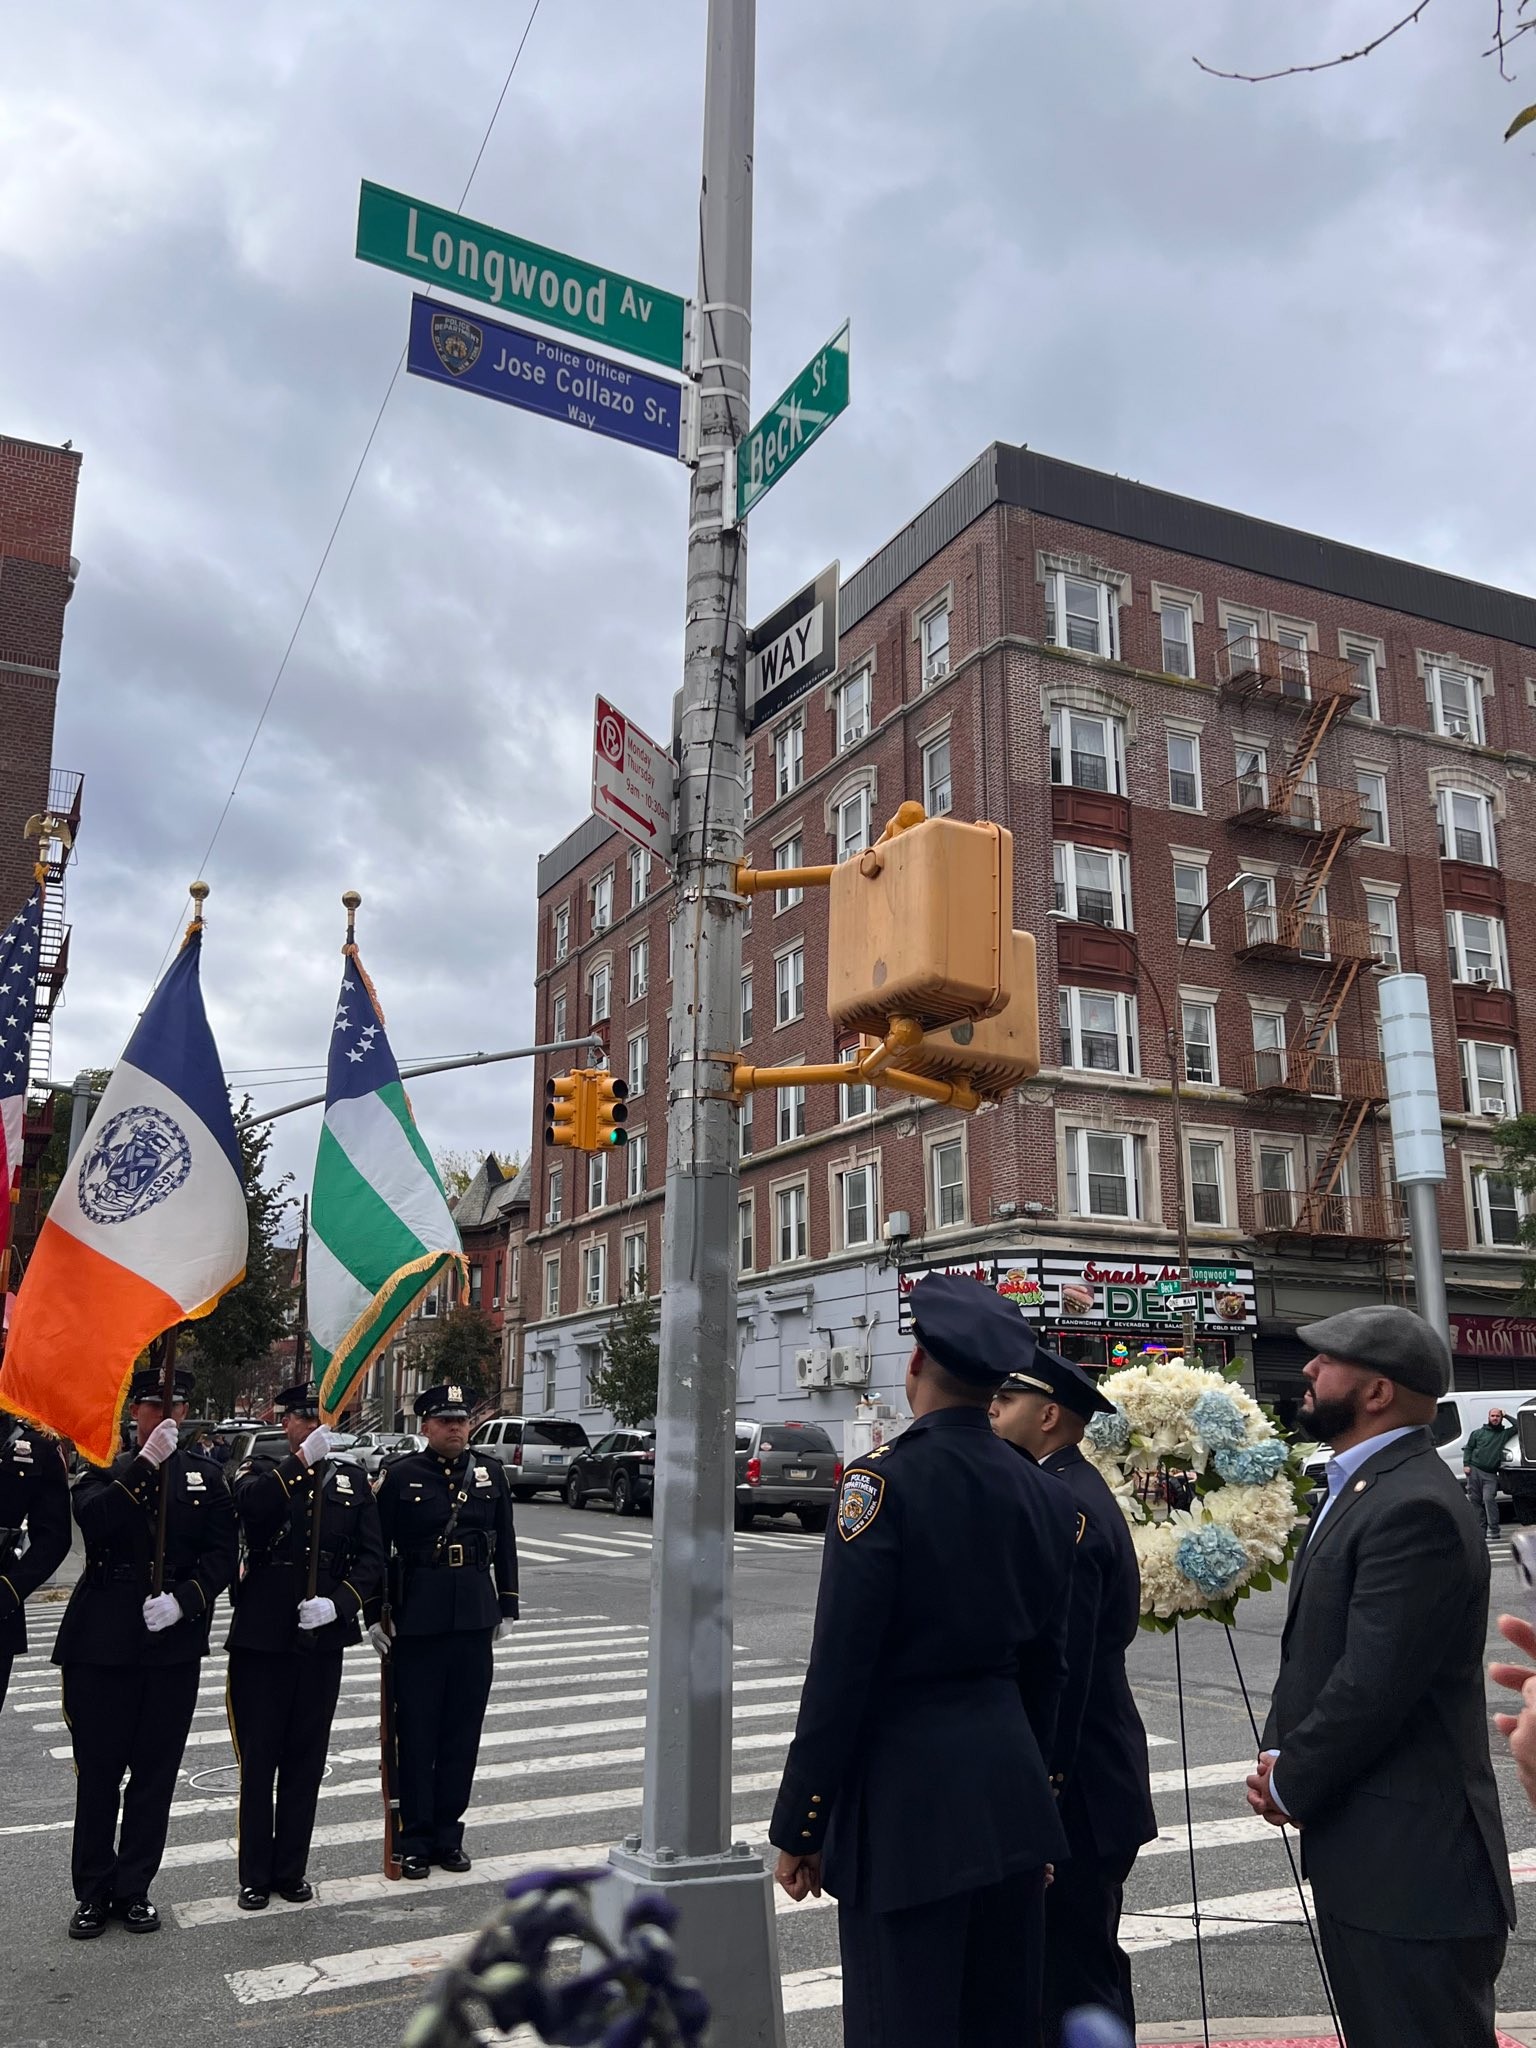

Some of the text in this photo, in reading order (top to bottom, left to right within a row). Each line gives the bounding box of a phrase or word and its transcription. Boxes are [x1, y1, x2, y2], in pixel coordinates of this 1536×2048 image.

[406, 207, 653, 325] Longwood Av
[434, 323, 480, 344] DEPARTMENT
[444, 317, 471, 333] POLICE
[536, 340, 632, 386] Police Officer
[492, 347, 672, 428] Jose Collazo Sr.
[567, 402, 597, 429] Way
[751, 351, 828, 485] Beck St
[760, 616, 813, 692] WAY
[787, 667, 829, 701] TRANSPORTATION
[627, 735, 652, 769] Monday
[627, 752, 656, 789] Thursday
[625, 777, 641, 800] 9am
[644, 792, 671, 823] 10:30am
[1083, 1260, 1148, 1285] Snack
[1191, 1269, 1227, 1282] Longwood
[1160, 1282, 1174, 1294] Beck
[1168, 1297, 1194, 1307] ONE WAY
[1061, 1319, 1102, 1327] SANDWICHES
[1466, 1328, 1515, 1356] SALON
[844, 1481, 878, 1496] DEPARTMENT
[850, 1473, 871, 1485] POLICE
[851, 1500, 878, 1533] NEW YORK
